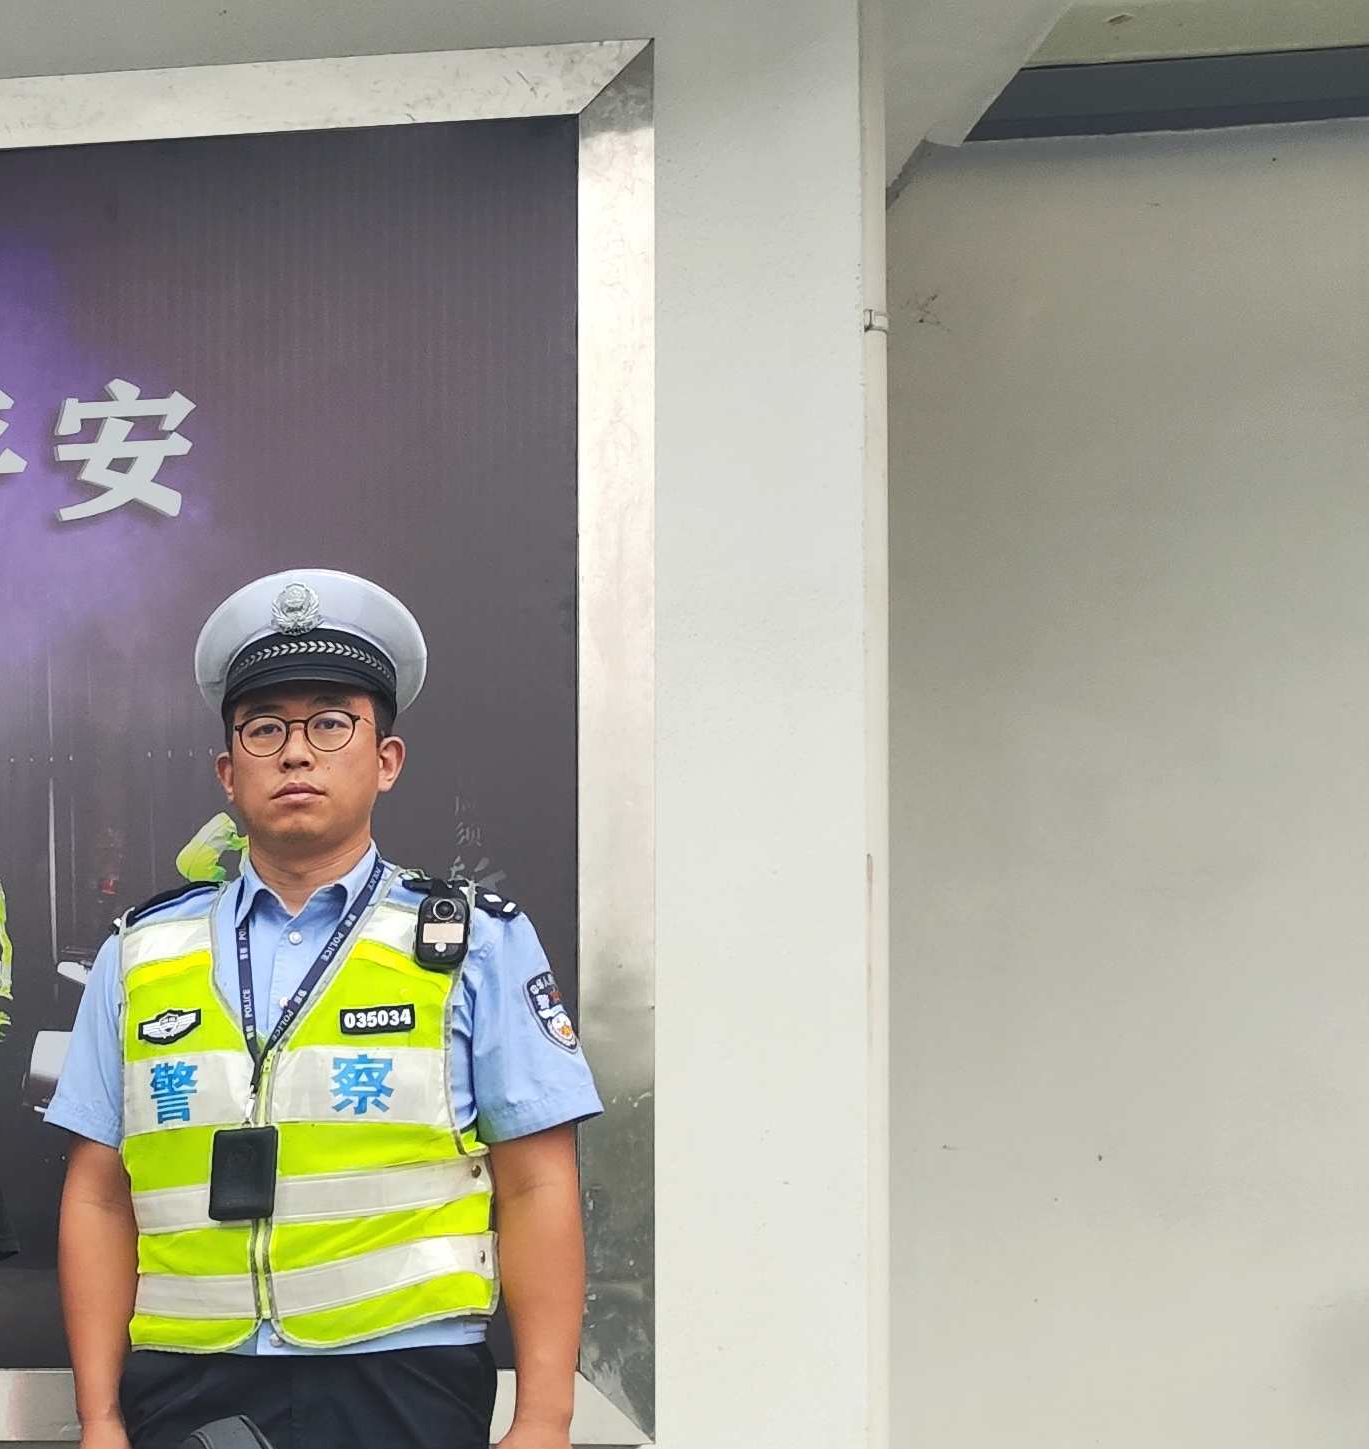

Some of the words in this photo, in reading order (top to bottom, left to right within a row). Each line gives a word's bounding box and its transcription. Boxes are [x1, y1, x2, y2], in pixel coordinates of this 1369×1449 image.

[343, 1008, 411, 1028] 035034
[149, 1061, 200, 1124] 警
[331, 1053, 394, 1116] 察
